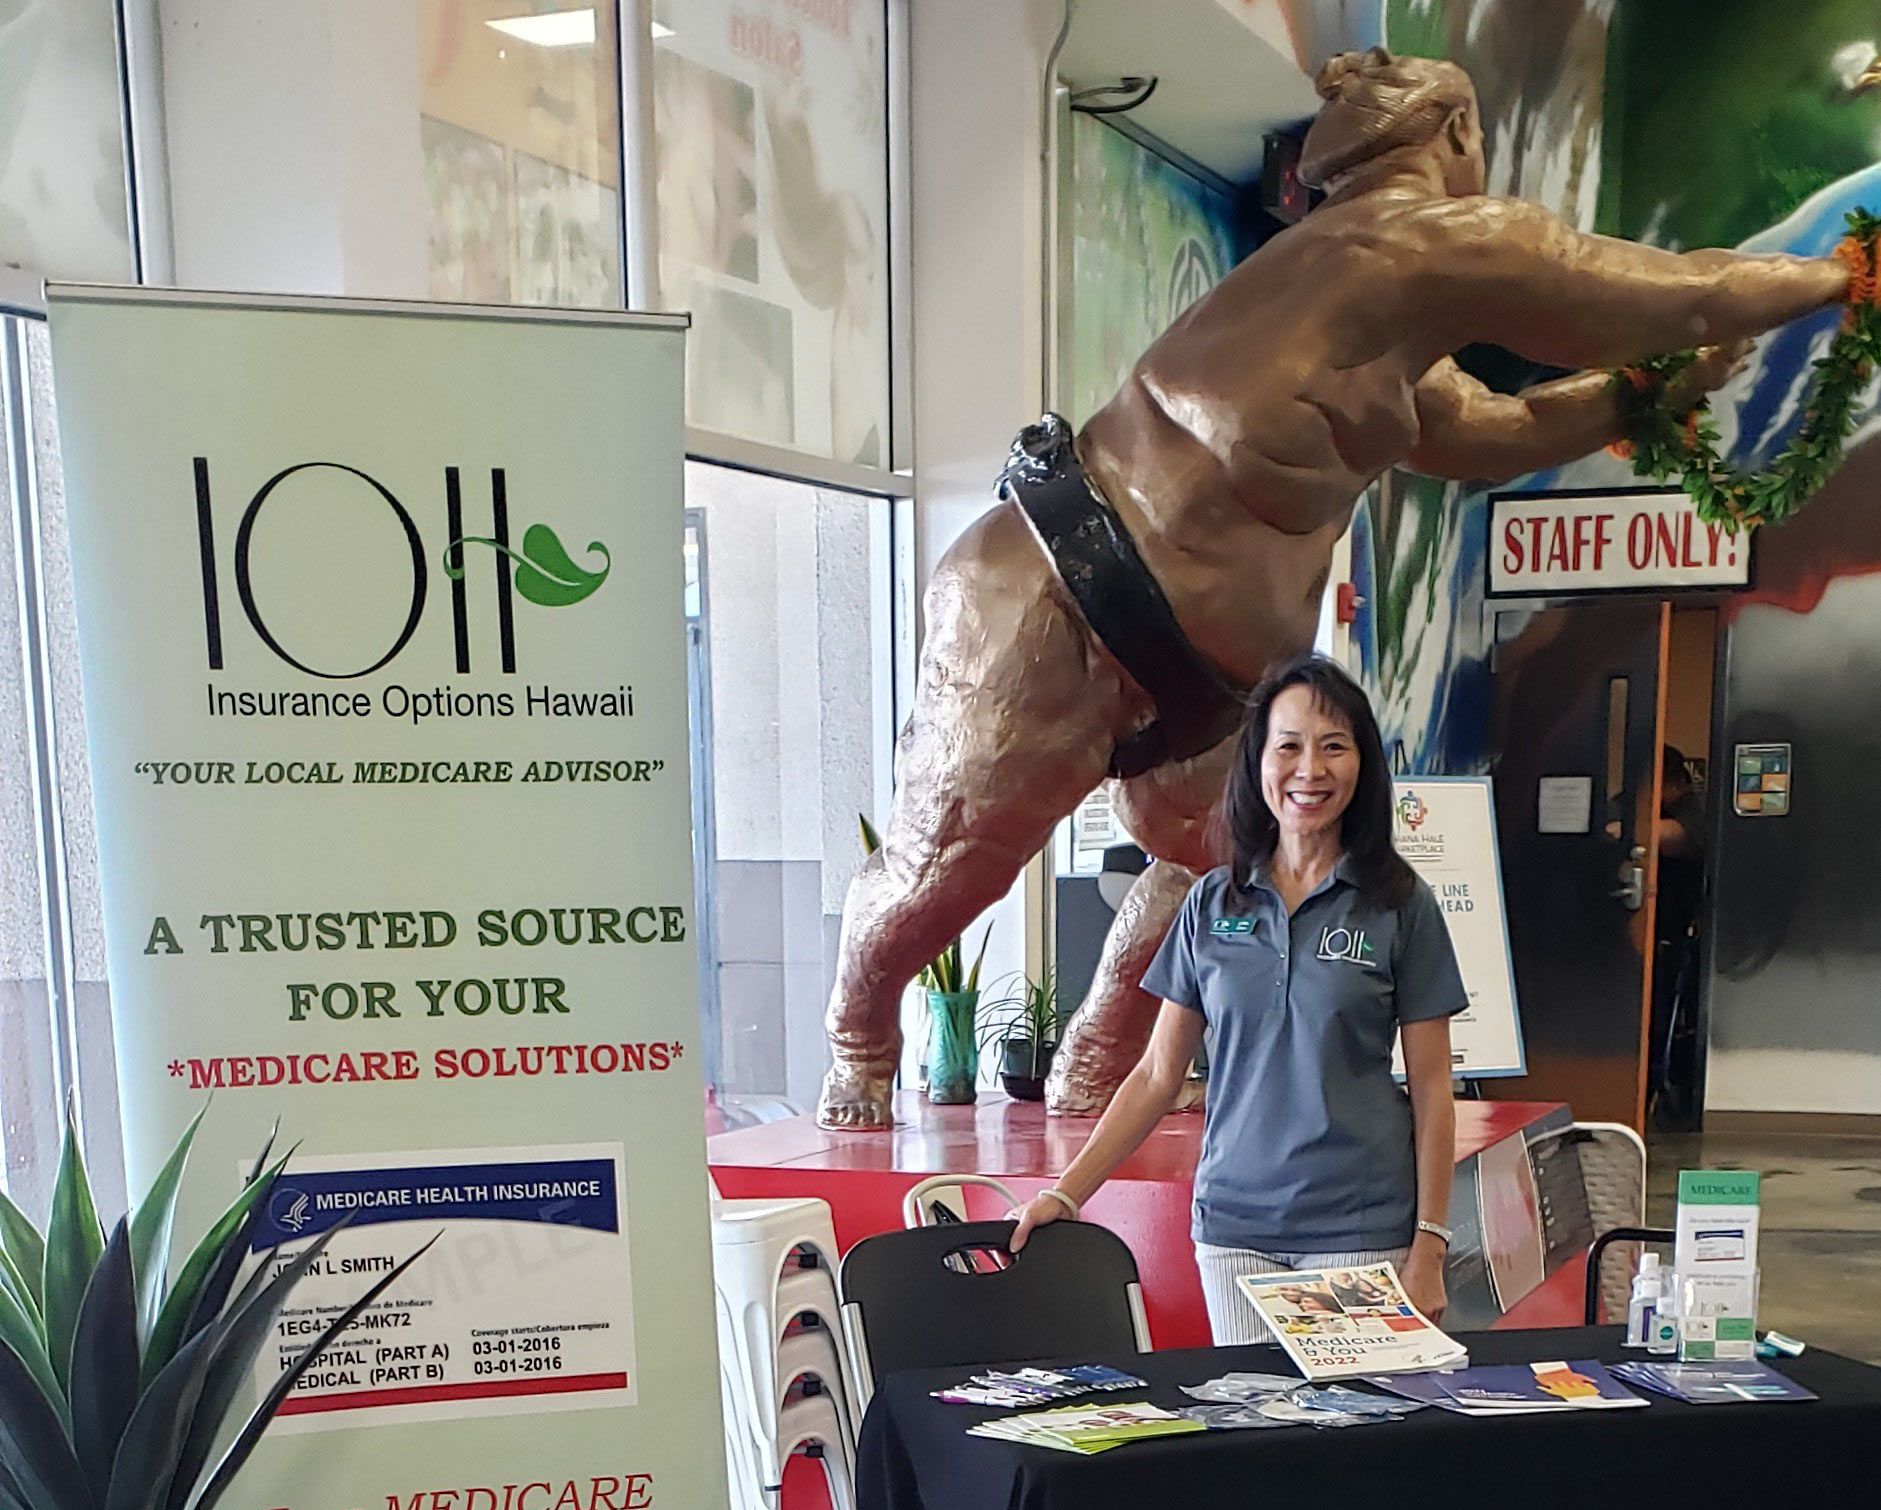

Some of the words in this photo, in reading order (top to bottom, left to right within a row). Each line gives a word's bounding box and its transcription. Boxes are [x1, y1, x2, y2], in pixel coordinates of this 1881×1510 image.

[1503, 514, 1615, 575] STAFF
[1627, 510, 1736, 570] ONLY!
[207, 683, 371, 717] Insurance
[382, 685, 515, 724] Options
[526, 685, 634, 717] Hawaii
[245, 762, 343, 785] LOCAL
[353, 761, 513, 784] MEDICARE
[1442, 884, 1470, 897] LINE
[144, 916, 183, 955] A
[200, 911, 457, 953] TRUSTED
[478, 907, 686, 948] SOURCE
[287, 981, 400, 1021] FOR
[416, 977, 570, 1018] YOUR
[316, 1188, 411, 1211] MEDICARE
[416, 1185, 488, 1205] HEALTH
[493, 1180, 600, 1201] INSURANCE
[1690, 1185, 1752, 1195] MEDICARE
[272, 1261, 320, 1279] JN
[327, 1261, 338, 1275] L
[341, 1255, 395, 1274] SMITH
[277, 1313, 412, 1337] 1EG4-T5-MK72
[473, 1337, 561, 1355] 03-01-2016
[1296, 1334, 1398, 1348] Medicare
[1323, 1346, 1367, 1356] You
[376, 1345, 427, 1365] (PART
[431, 1344, 449, 1362] A)
[474, 1356, 562, 1375] 03-01-2016
[1312, 1357, 1360, 1366] 2022
[291, 1370, 361, 1390] EDICAL
[370, 1366, 421, 1386] (PART
[426, 1364, 444, 1381] B)
